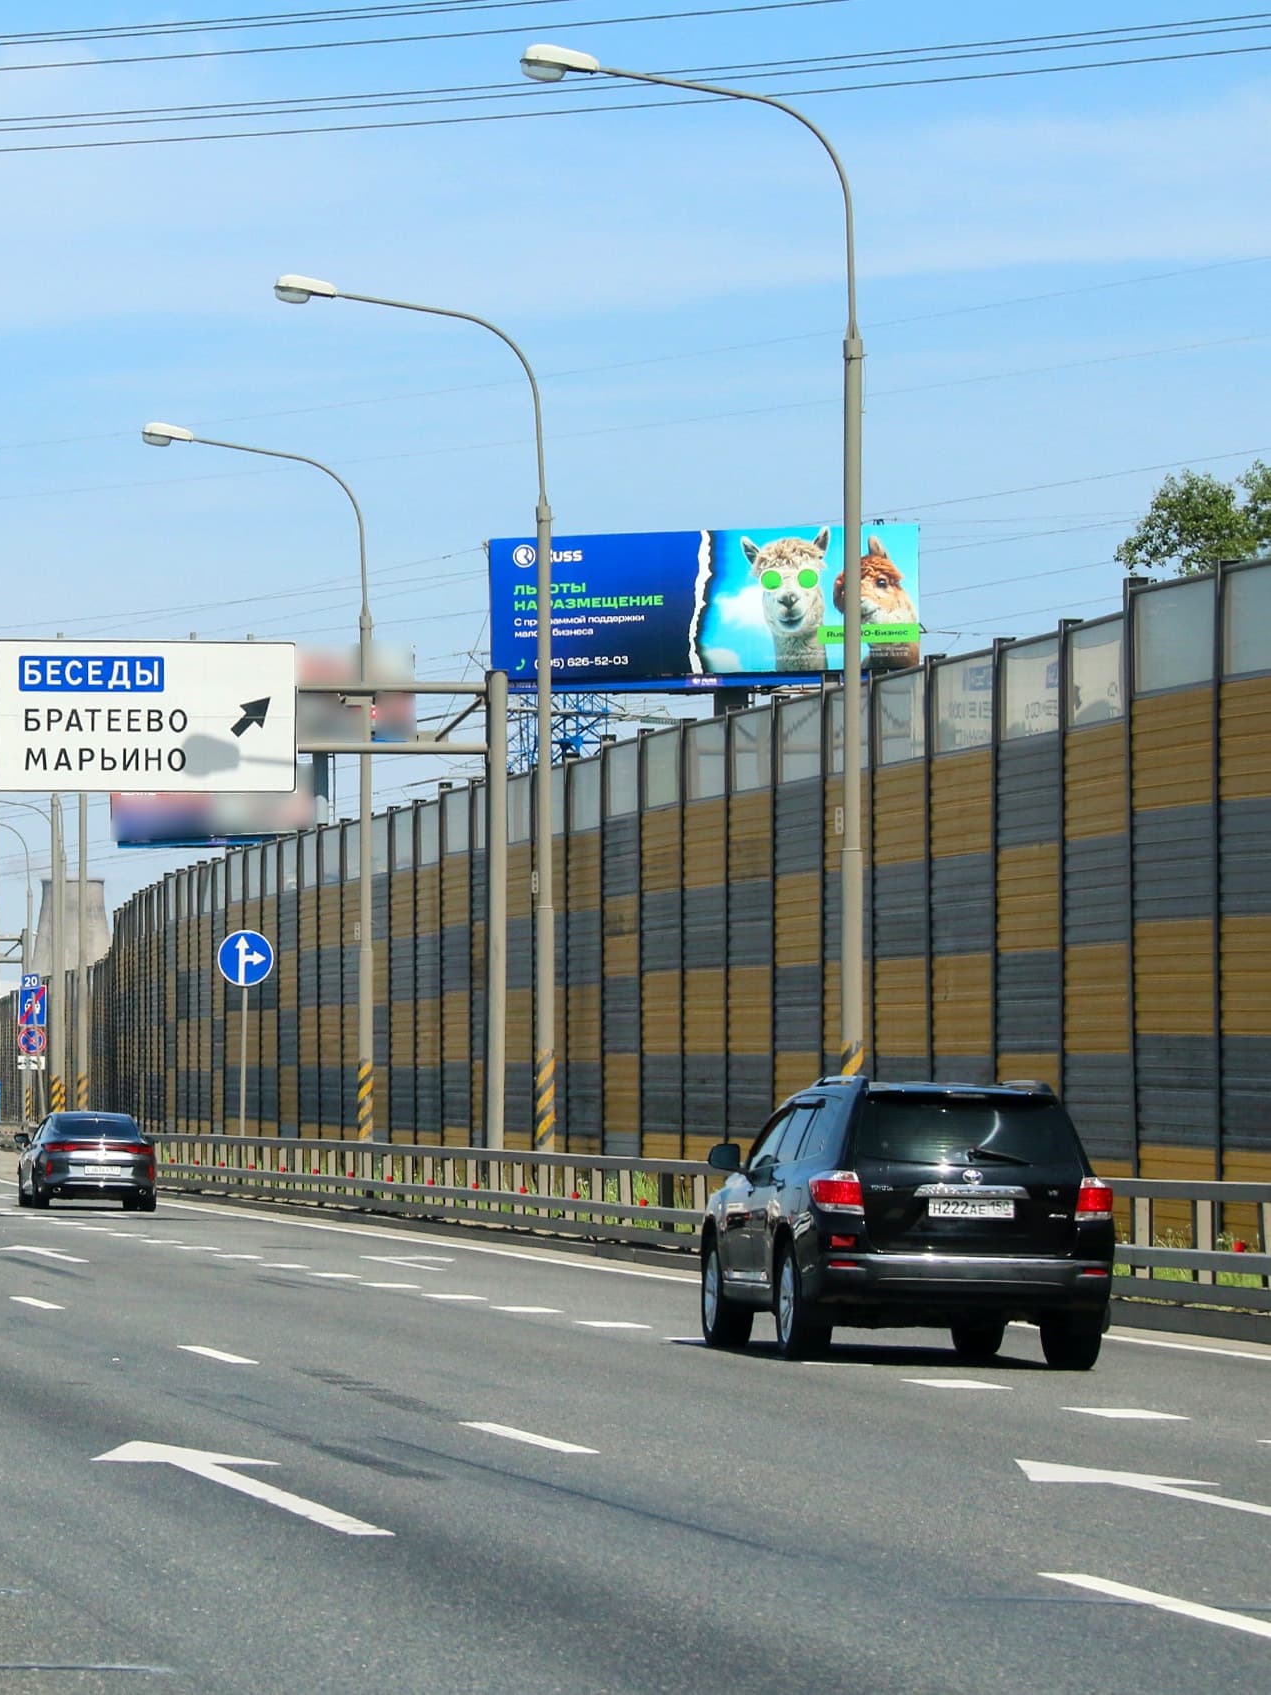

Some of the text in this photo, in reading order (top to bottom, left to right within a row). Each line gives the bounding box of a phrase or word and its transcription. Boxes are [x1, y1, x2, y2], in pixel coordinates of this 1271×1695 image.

[513, 582, 586, 596] ЛЬОТЫ
[550, 595, 664, 609] АЗМЕЩЕНИЕ
[514, 617, 522, 626] С
[534, 655, 629, 670] (5) 626-52-03
[24, 660, 159, 690] БЕСЕДЫ
[24, 708, 188, 733] БРАТЕЕВО
[25, 747, 187, 772] МАРЬИНО
[24, 976, 38, 987] 20
